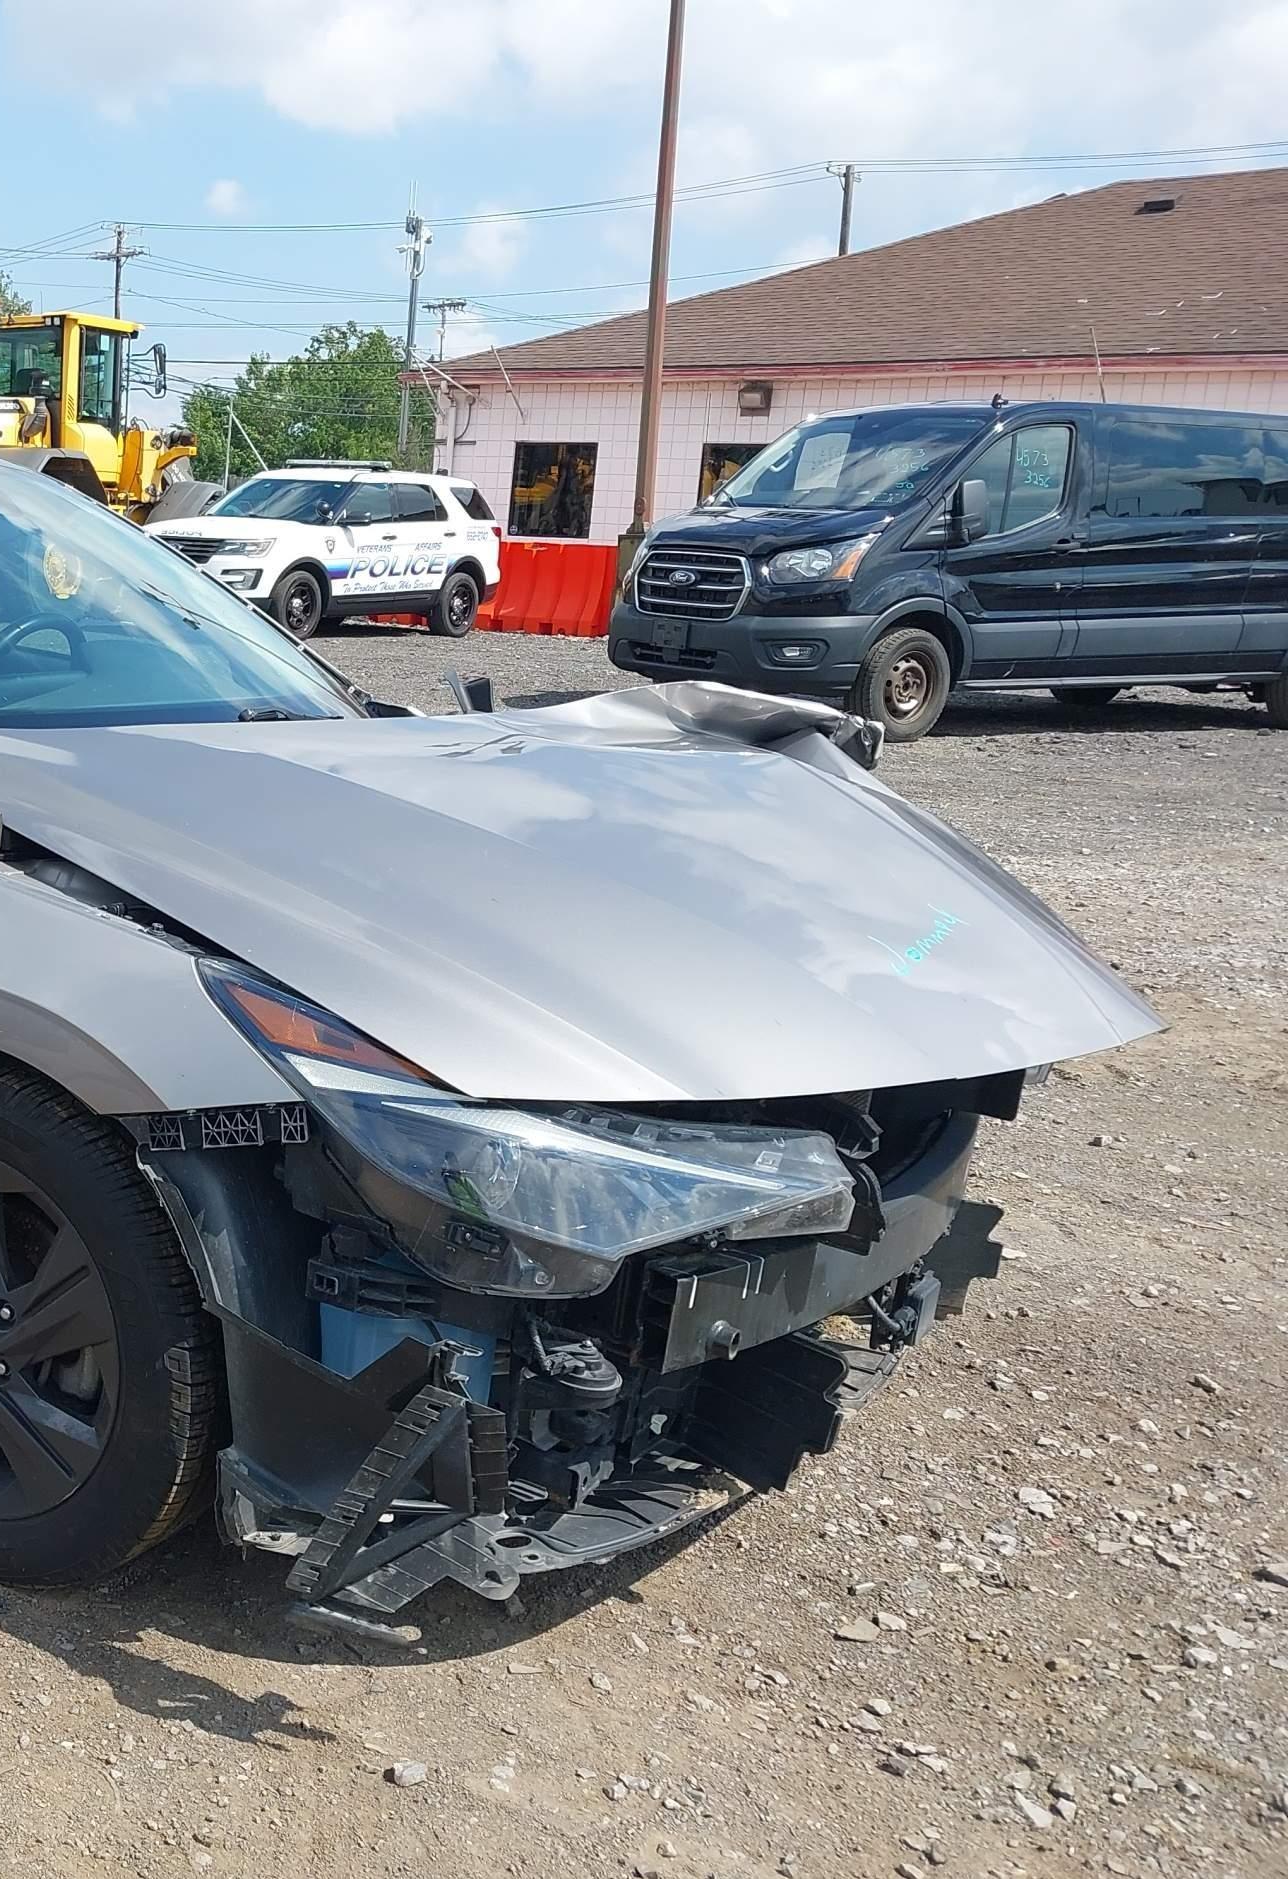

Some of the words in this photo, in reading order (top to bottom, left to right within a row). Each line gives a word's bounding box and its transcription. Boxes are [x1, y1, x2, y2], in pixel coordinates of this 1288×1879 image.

[1016, 447, 1049, 467] 4573
[1024, 469, 1050, 488] 3256
[357, 544, 393, 554] VETERANS
[414, 542, 442, 551] AFFAIRS
[350, 553, 447, 579] POLICE
[343, 583, 351, 594] To
[353, 582, 377, 593] Protect
[379, 581, 396, 591] Those
[398, 580, 412, 590] Who
